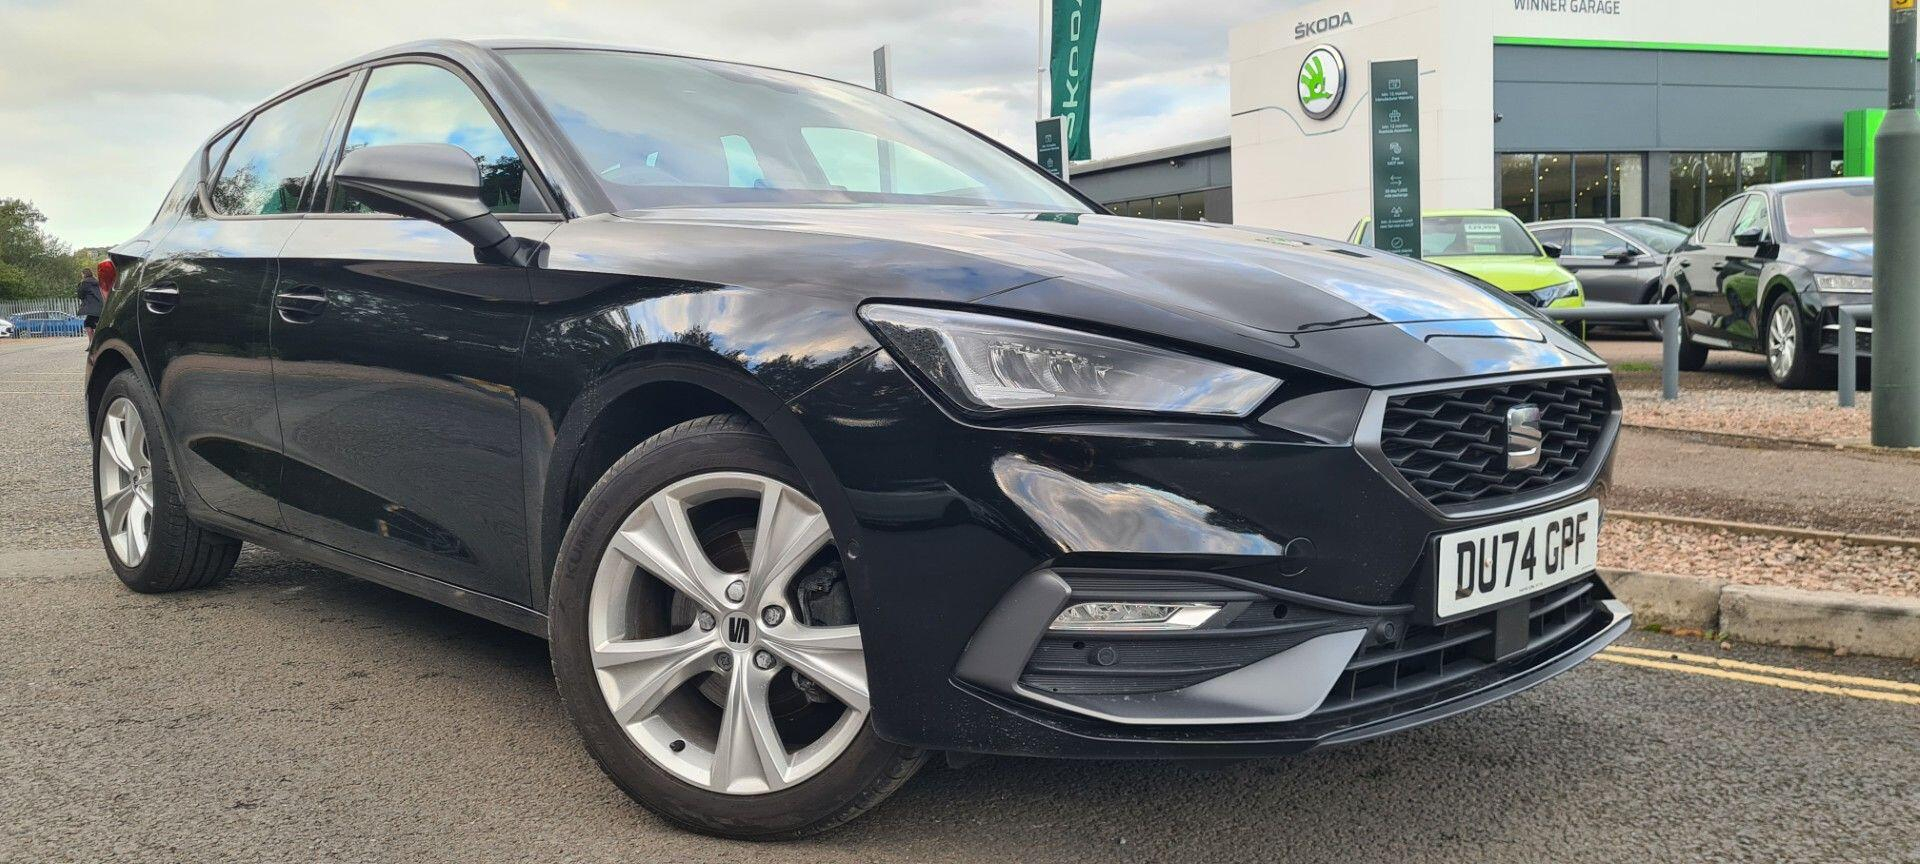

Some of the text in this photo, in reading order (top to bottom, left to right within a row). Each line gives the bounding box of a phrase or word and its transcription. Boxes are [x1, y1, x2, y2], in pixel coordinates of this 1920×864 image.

[1295, 11, 1353, 39] ŠKODA
[1514, 0, 1620, 14] WINNER GARAGE
[1062, 0, 1083, 139] KOD
[1455, 511, 1588, 600] DU74 GPF
